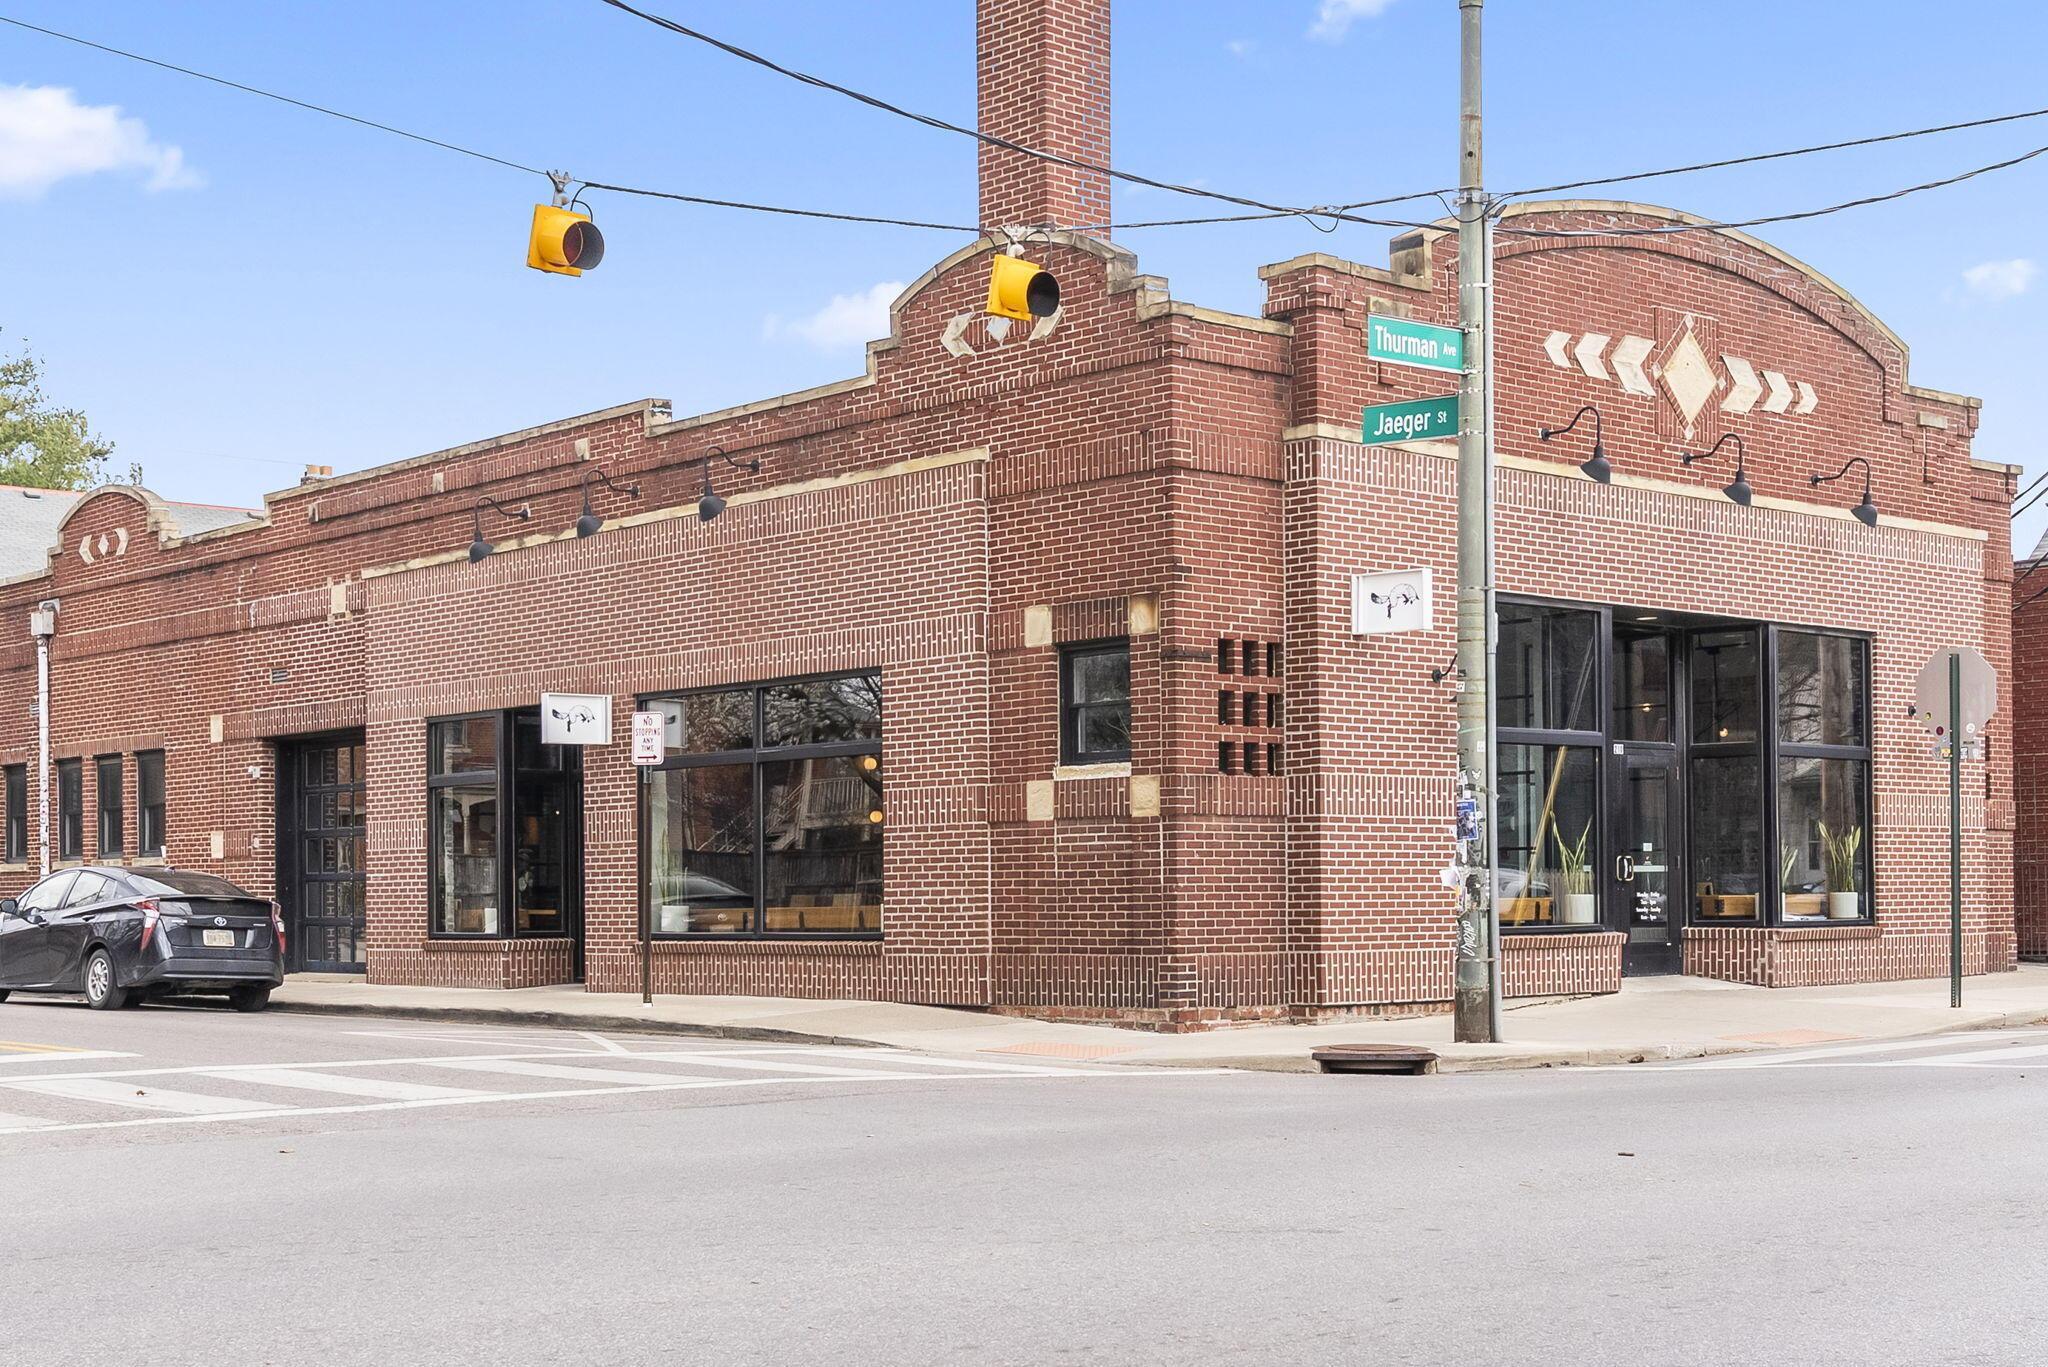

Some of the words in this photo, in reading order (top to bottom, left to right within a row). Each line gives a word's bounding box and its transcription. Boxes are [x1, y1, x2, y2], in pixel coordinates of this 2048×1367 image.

[1375, 325, 1438, 359] Thurman
[1442, 342, 1457, 357] Ave
[1373, 411, 1431, 439] Jaeger
[1437, 410, 1448, 424] St
[643, 718, 653, 726] NO
[635, 728, 660, 736] STOPPING
[641, 745, 655, 753] TIME
